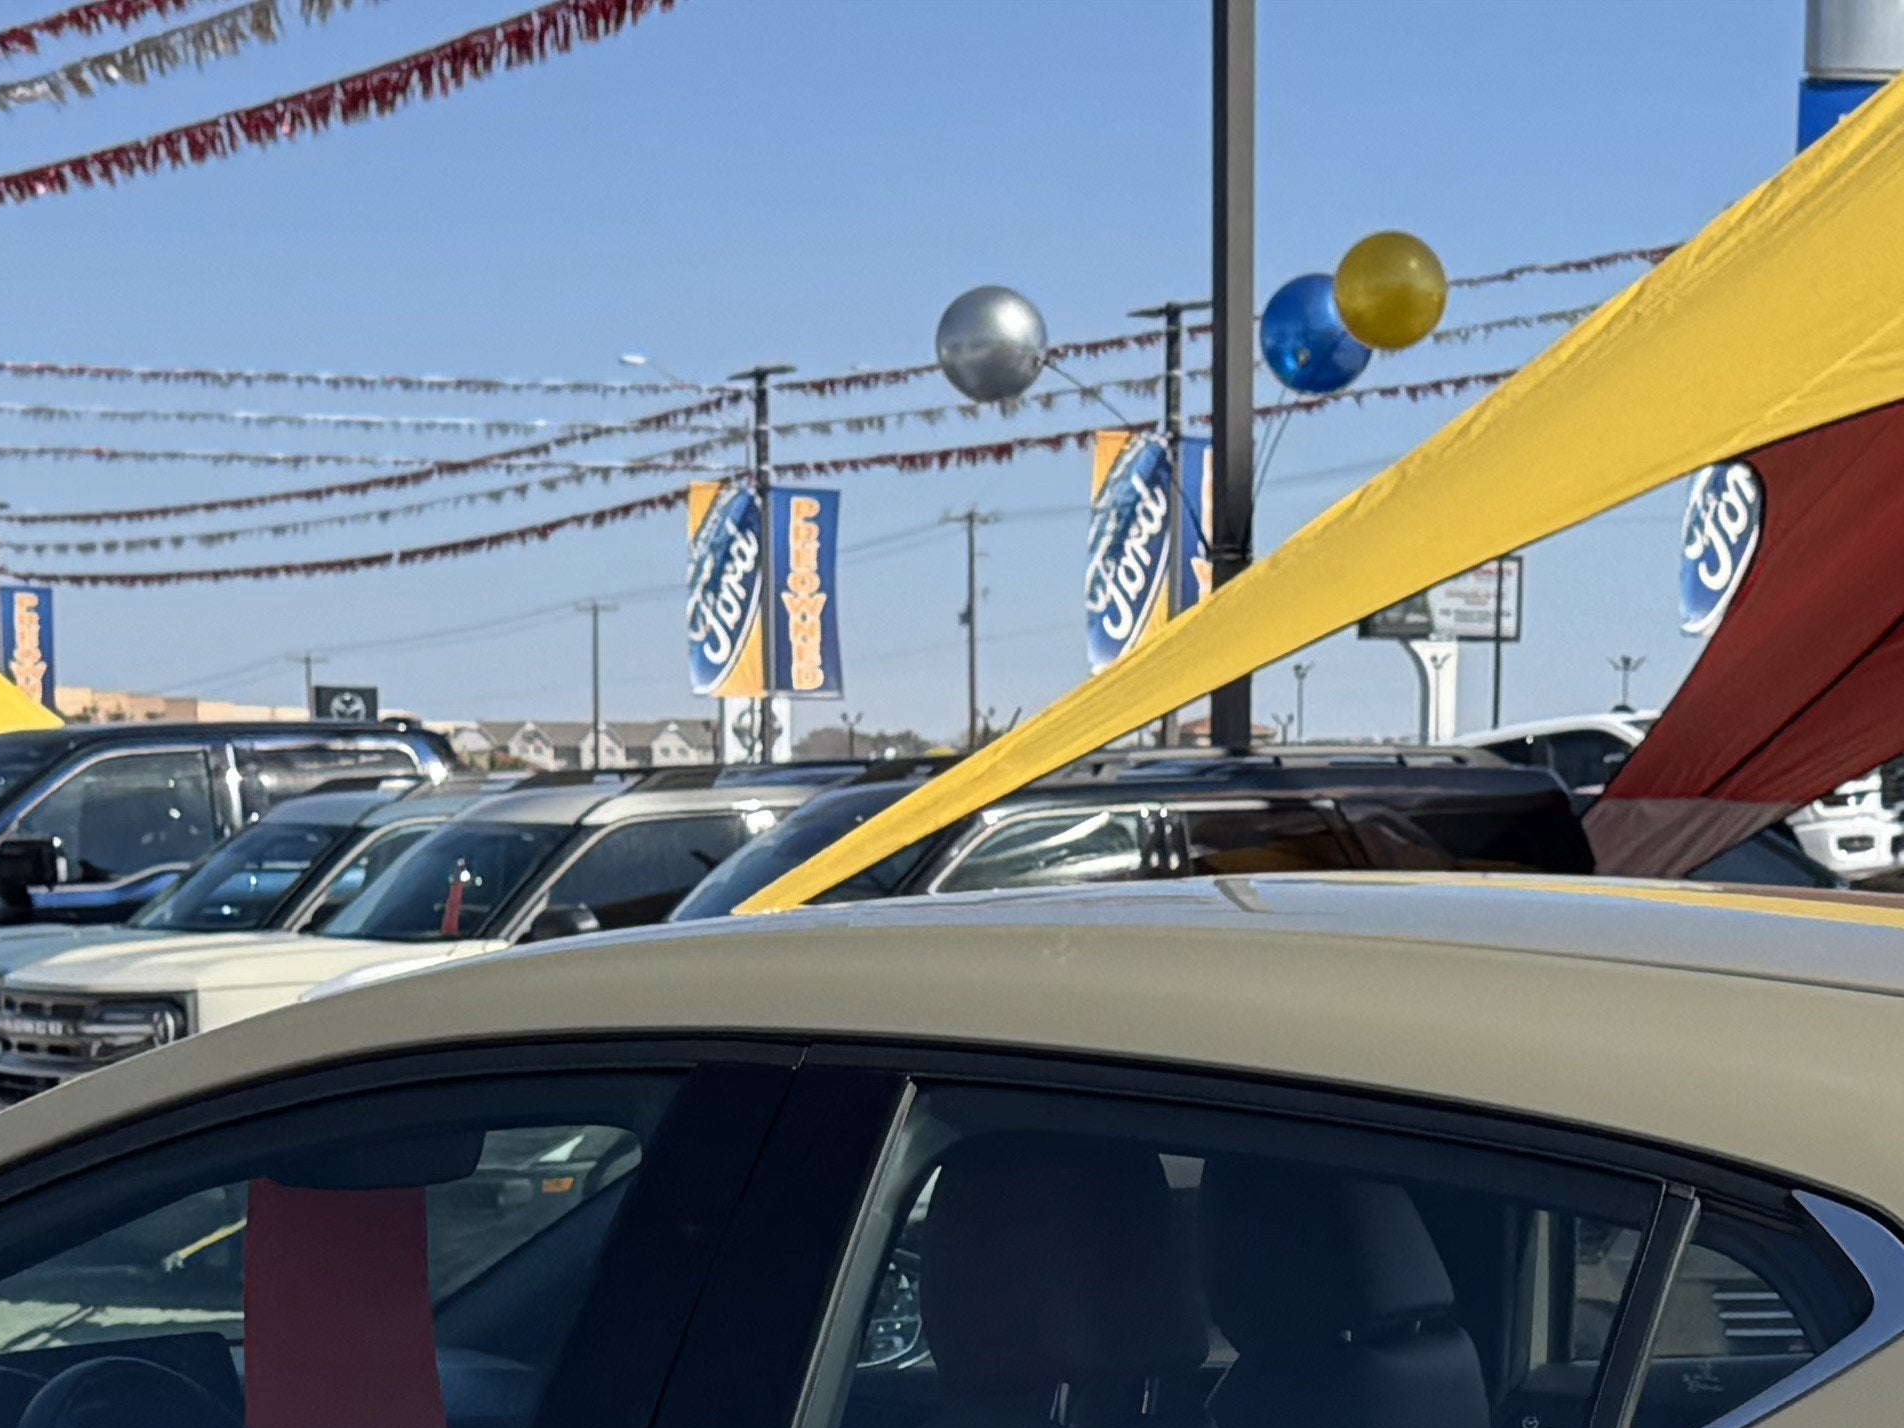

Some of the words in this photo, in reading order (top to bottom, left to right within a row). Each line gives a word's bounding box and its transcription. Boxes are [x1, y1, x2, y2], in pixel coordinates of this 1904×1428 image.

[686, 516, 760, 664] Ford
[1085, 472, 1168, 640] Ford
[1680, 463, 1757, 591] For
